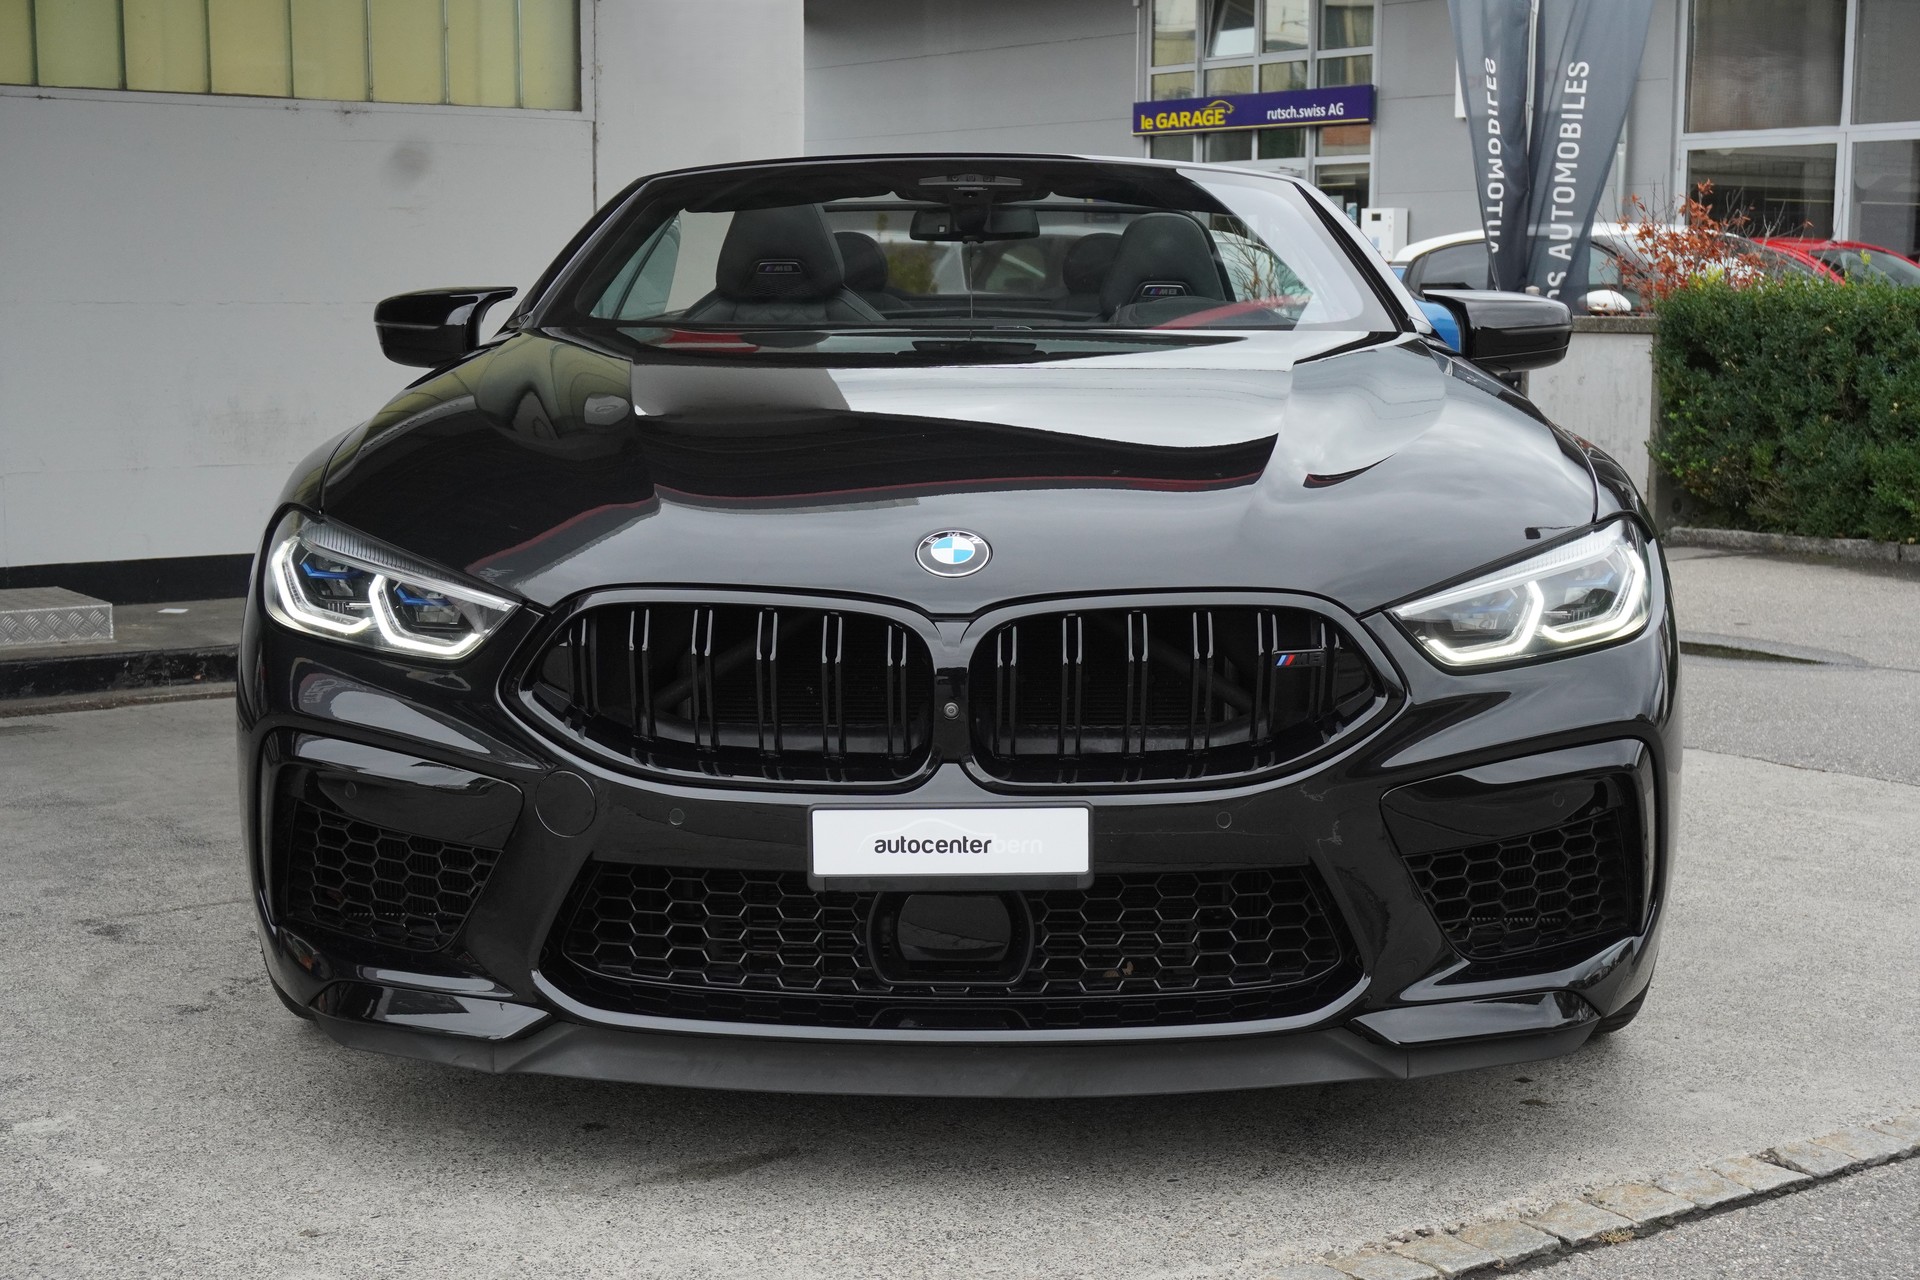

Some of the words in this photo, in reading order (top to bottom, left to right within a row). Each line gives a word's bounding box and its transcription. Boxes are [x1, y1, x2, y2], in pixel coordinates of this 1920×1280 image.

[1140, 115, 1154, 130] le
[1156, 109, 1226, 128] GARAGE
[1266, 105, 1326, 120] rutsch.swiss
[1327, 102, 1344, 116] AG
[1548, 61, 1590, 261] AUTOMOBILES
[925, 532, 983, 544] BMW
[873, 835, 992, 854] autocenter
